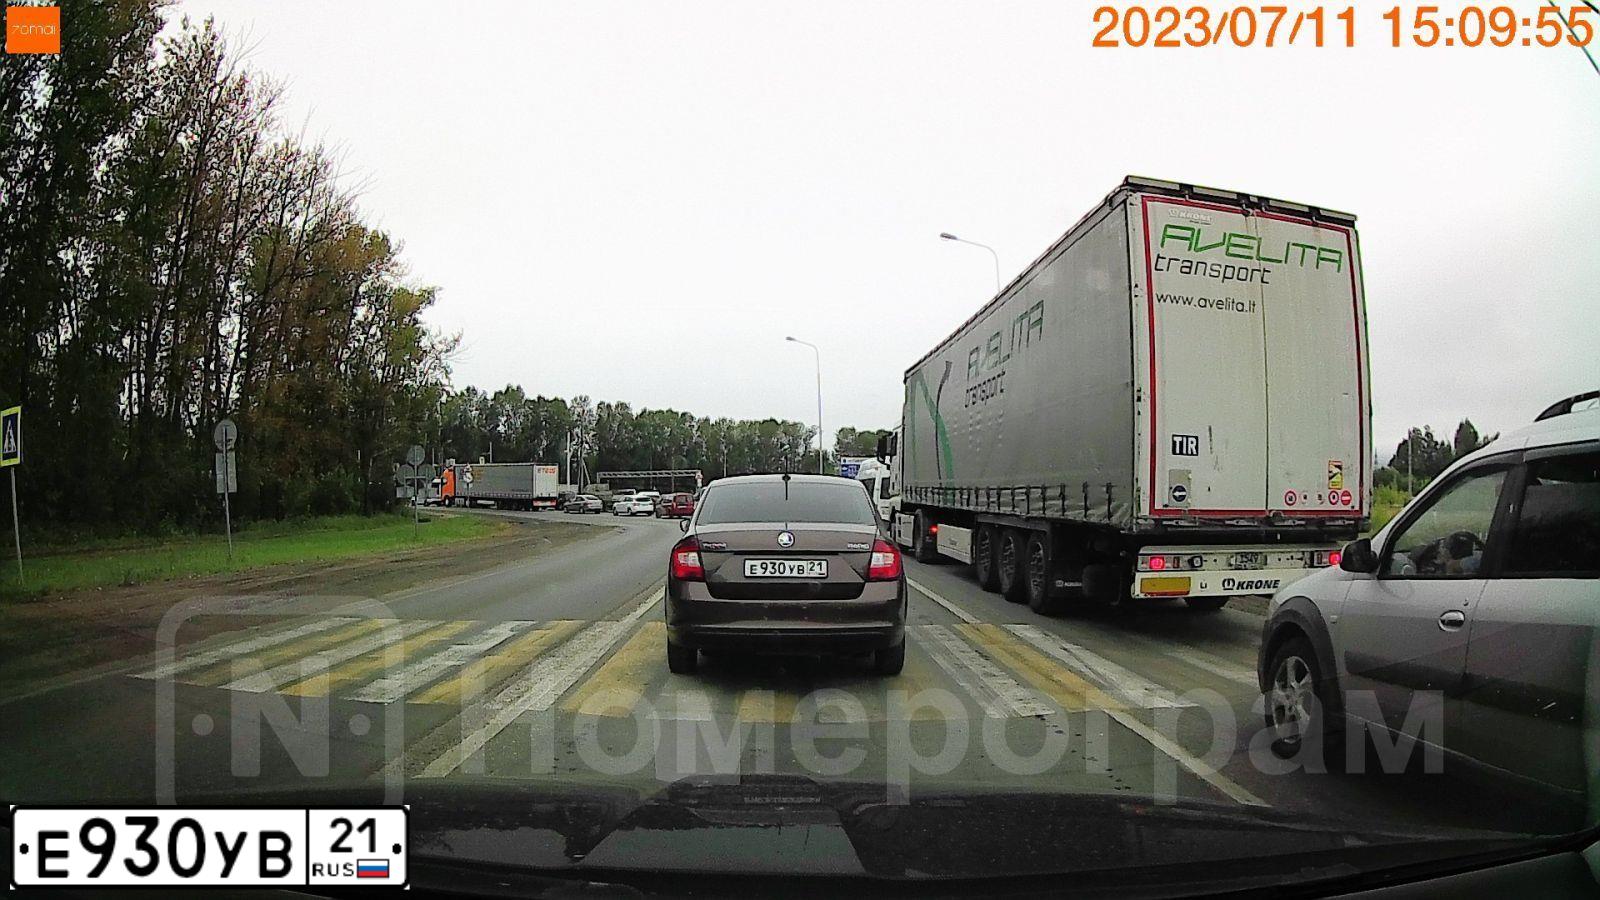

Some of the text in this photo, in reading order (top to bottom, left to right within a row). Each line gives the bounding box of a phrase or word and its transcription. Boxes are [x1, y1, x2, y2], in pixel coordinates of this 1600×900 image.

[1160, 224, 1343, 273] AVELITA
[1154, 253, 1271, 284] transport
[1155, 292, 1256, 313] www.avelita.lt
[1173, 436, 1197, 455] TIR
[808, 561, 823, 572] 21
[1236, 579, 1281, 591] KRONE
